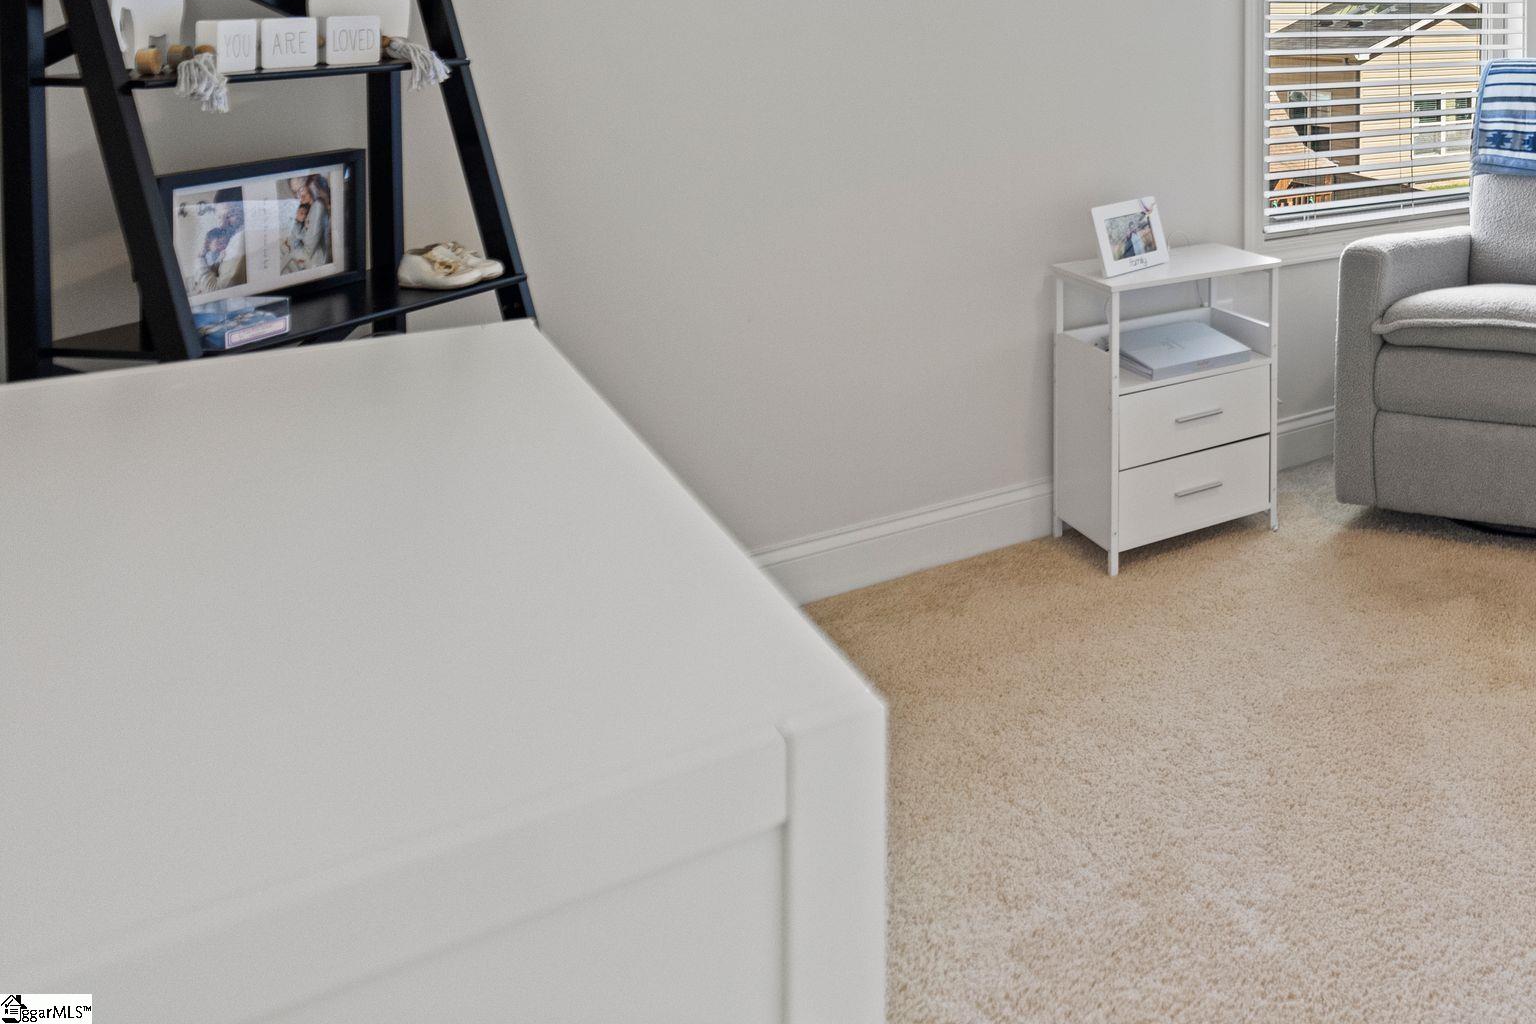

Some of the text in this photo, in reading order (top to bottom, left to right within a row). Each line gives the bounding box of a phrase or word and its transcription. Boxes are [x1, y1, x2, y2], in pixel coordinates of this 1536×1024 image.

[223, 28, 376, 58] YOU ARE LOVED
